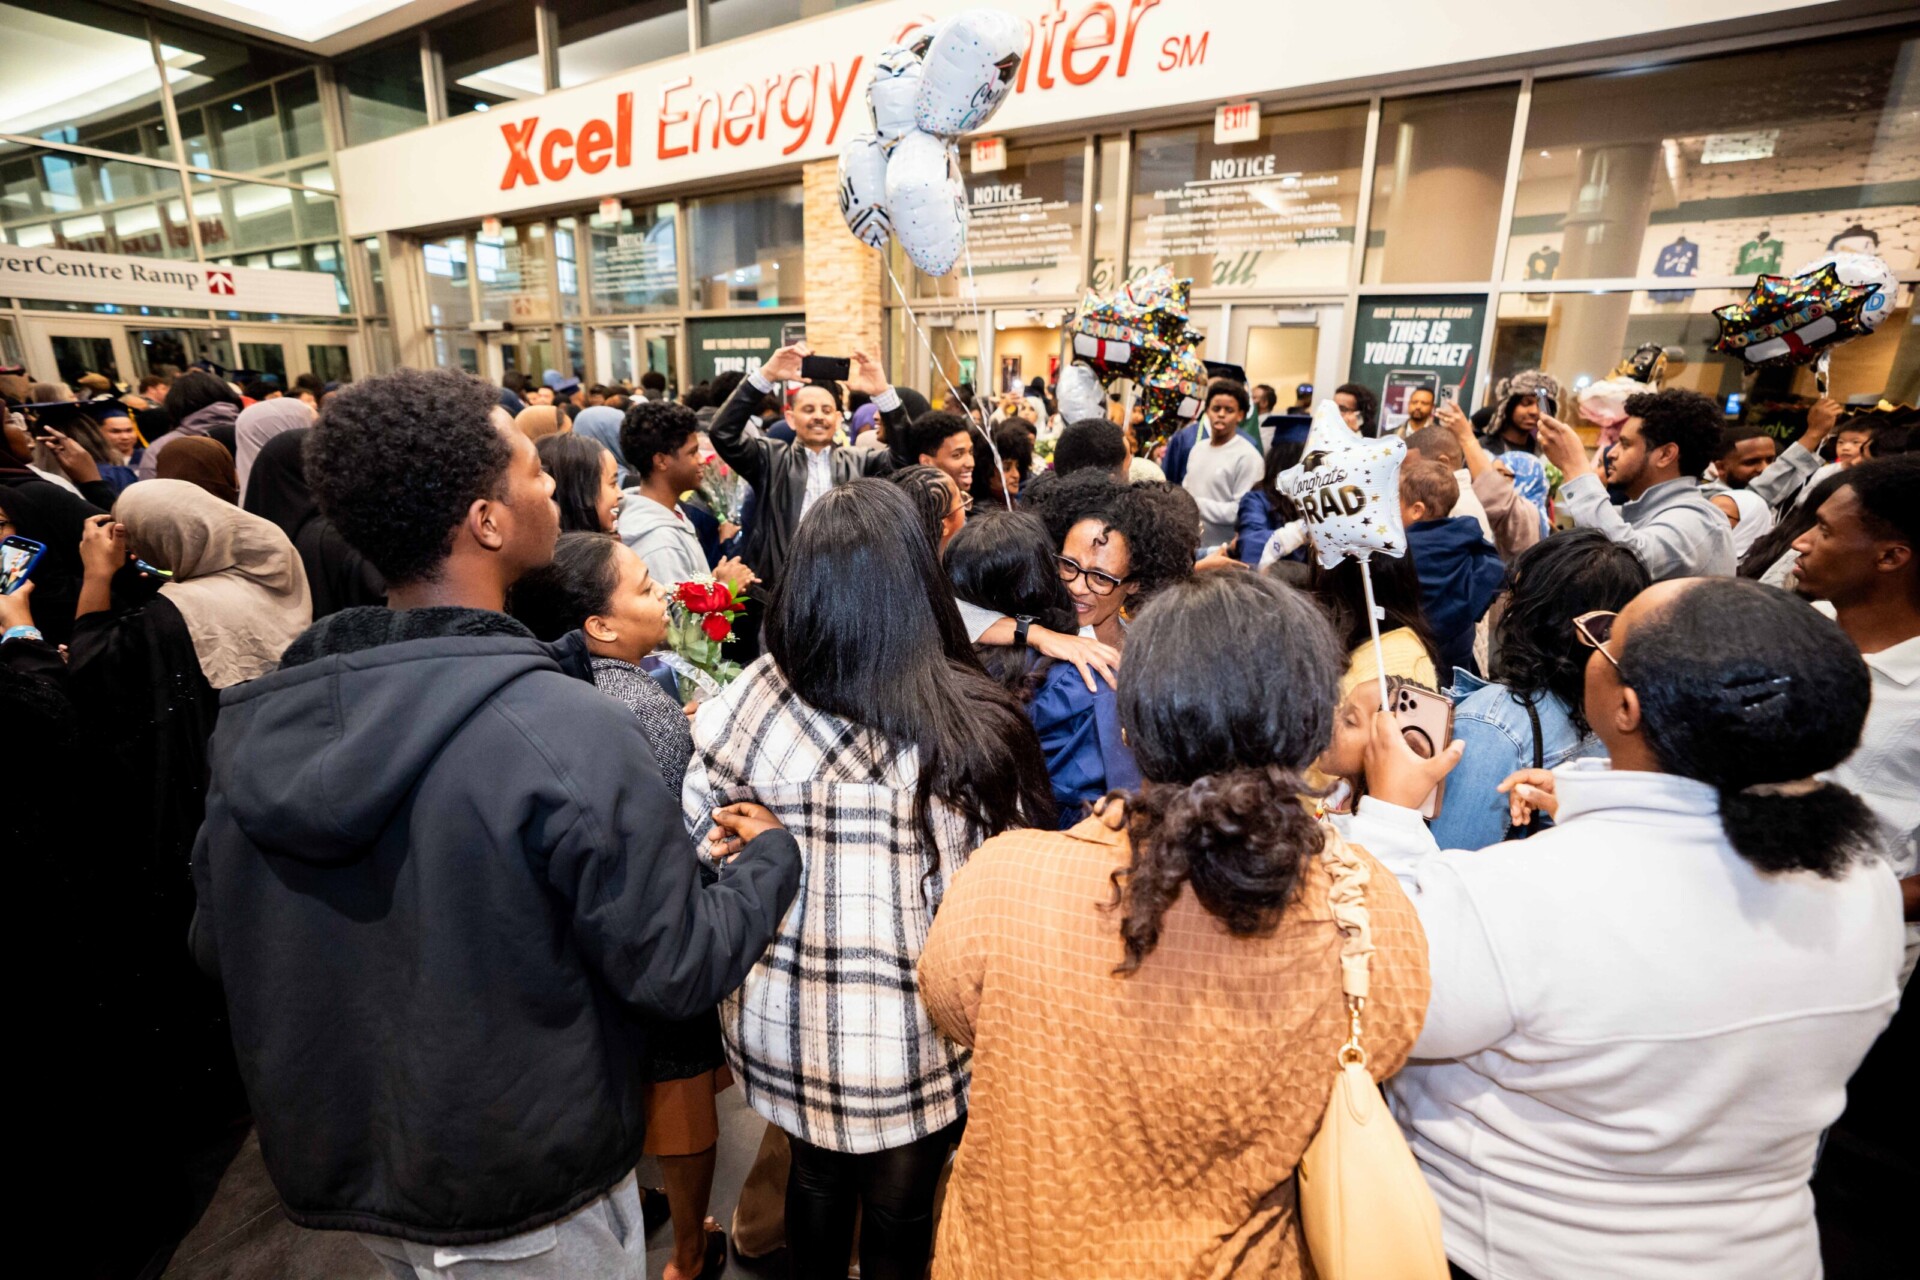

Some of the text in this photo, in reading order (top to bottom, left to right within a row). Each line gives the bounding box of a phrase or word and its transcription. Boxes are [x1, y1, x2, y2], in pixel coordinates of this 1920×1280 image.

[499, 91, 634, 190] Xcel
[657, 55, 864, 160] Energy
[1157, 31, 1210, 72] SM
[1223, 103, 1252, 130] EXIT
[976, 139, 999, 161] EXIT
[1210, 155, 1276, 180] NOTICE
[974, 183, 1022, 204] NOTICE
[129, 263, 200, 291] Ramp
[1388, 320, 1452, 344] THIS IS
[1363, 342, 1473, 367] YOUR TICKET
[1292, 465, 1349, 497] Congrats
